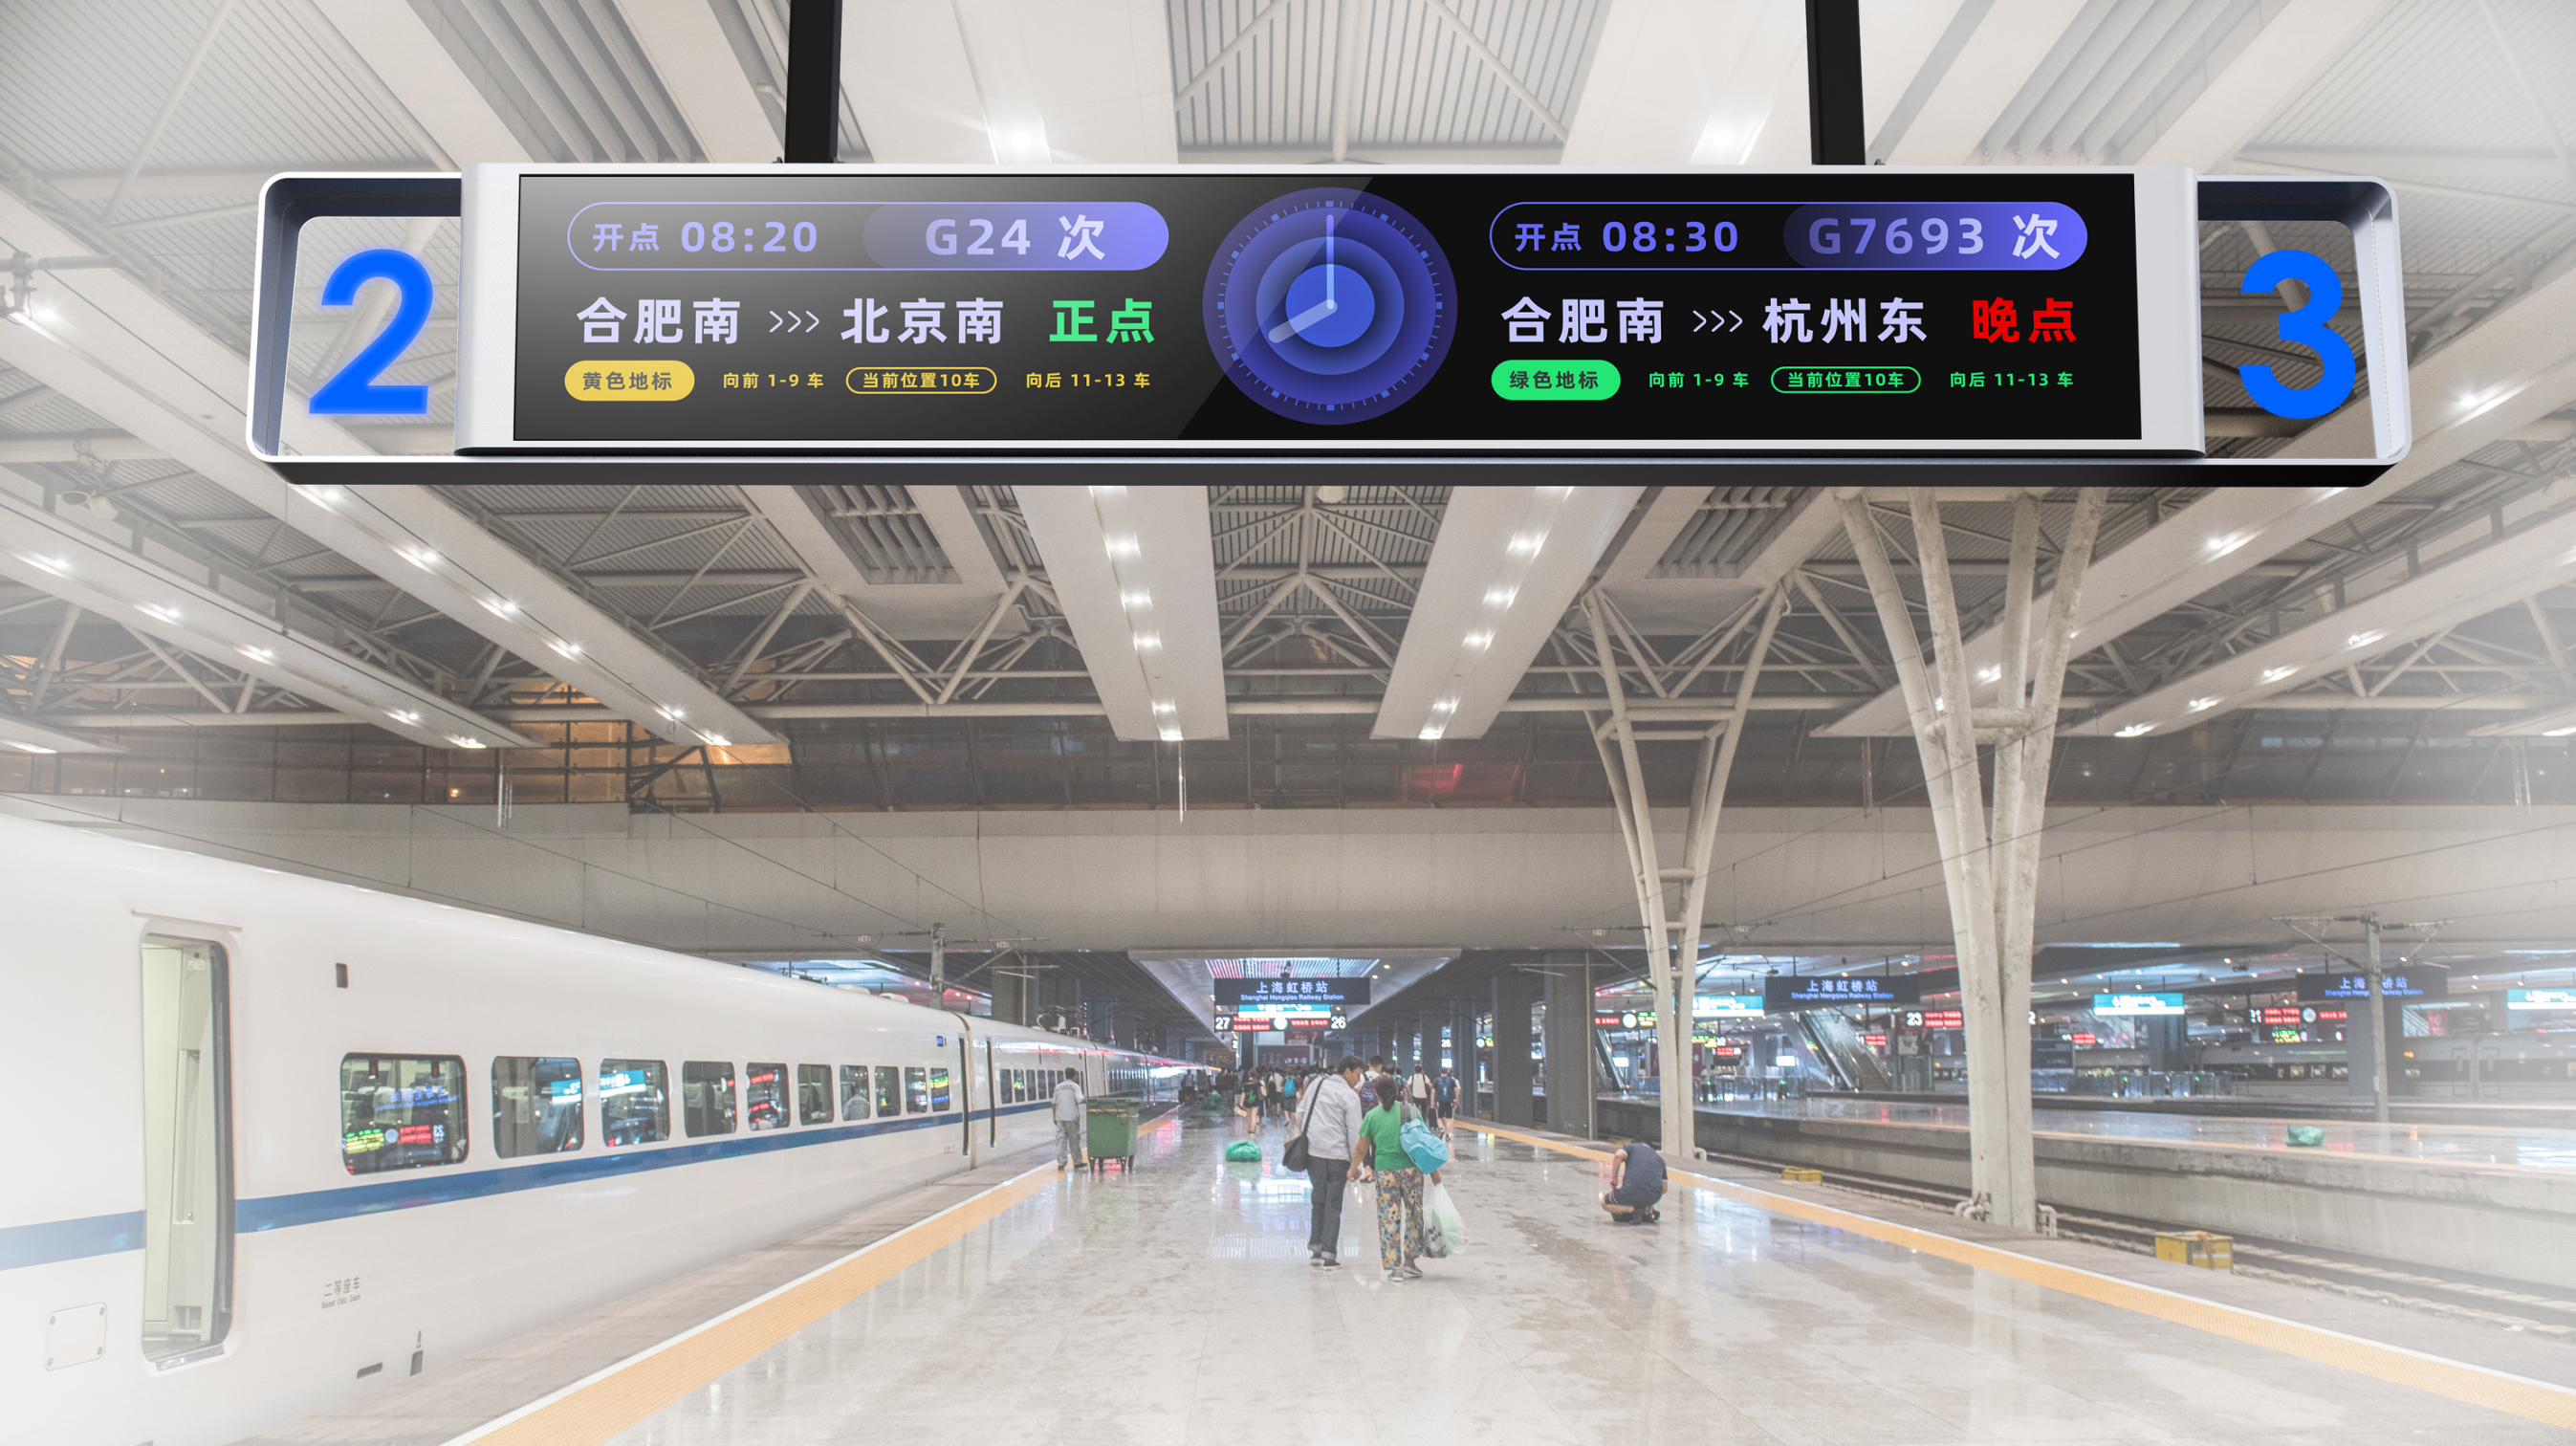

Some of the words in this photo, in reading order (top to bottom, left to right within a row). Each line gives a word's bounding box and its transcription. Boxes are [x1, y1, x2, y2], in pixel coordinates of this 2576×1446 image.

[593, 223, 659, 252] 开点
[682, 222, 817, 252] 08:20
[926, 219, 1030, 255] G24
[1058, 214, 1105, 260] 次
[1516, 223, 1582, 252] 开点
[1603, 222, 1737, 252] 08:30
[1809, 218, 1983, 254] G7693
[2013, 213, 2060, 259] 次
[577, 296, 740, 344] 合肥南
[840, 297, 1003, 344] 北京南
[1050, 298, 1154, 343] 正点
[1501, 296, 1664, 343] 合肥南
[1762, 297, 1927, 343] 杭州东
[1973, 297, 2076, 343] 晚点
[309, 249, 433, 414] 2
[2238, 249, 2356, 419] 3
[582, 371, 672, 390] 黄色地标
[724, 373, 758, 388] 向前
[769, 374, 798, 386] 1-9
[808, 372, 823, 388] 车
[862, 372, 980, 388] 当前位置10车
[1027, 372, 1061, 388] 向后
[1071, 374, 1124, 386] 11-13
[1134, 372, 1149, 387] 车
[1510, 370, 1599, 389] 绿色地标
[1649, 372, 1684, 387] 向前
[1693, 374, 1724, 385] 1-9
[1733, 372, 1748, 387] 车
[1787, 371, 1904, 387] 当前位置10车
[1951, 372, 1985, 387] 向后
[1995, 373, 2048, 385] 11-13
[2058, 372, 2073, 387] 车
[1256, 980, 1328, 994] 上海虹桥站
[1806, 978, 1878, 993] 上海虹桥站
[2339, 975, 2408, 990] 上海桥站
[1791, 992, 1820, 1000] Shanghai
[1820, 992, 1848, 1000] Hongqiao
[1848, 992, 1872, 1000] Railway
[1214, 1017, 1231, 1030] 27
[1330, 1016, 1346, 1030] 26
[1906, 1012, 1923, 1026] 23
